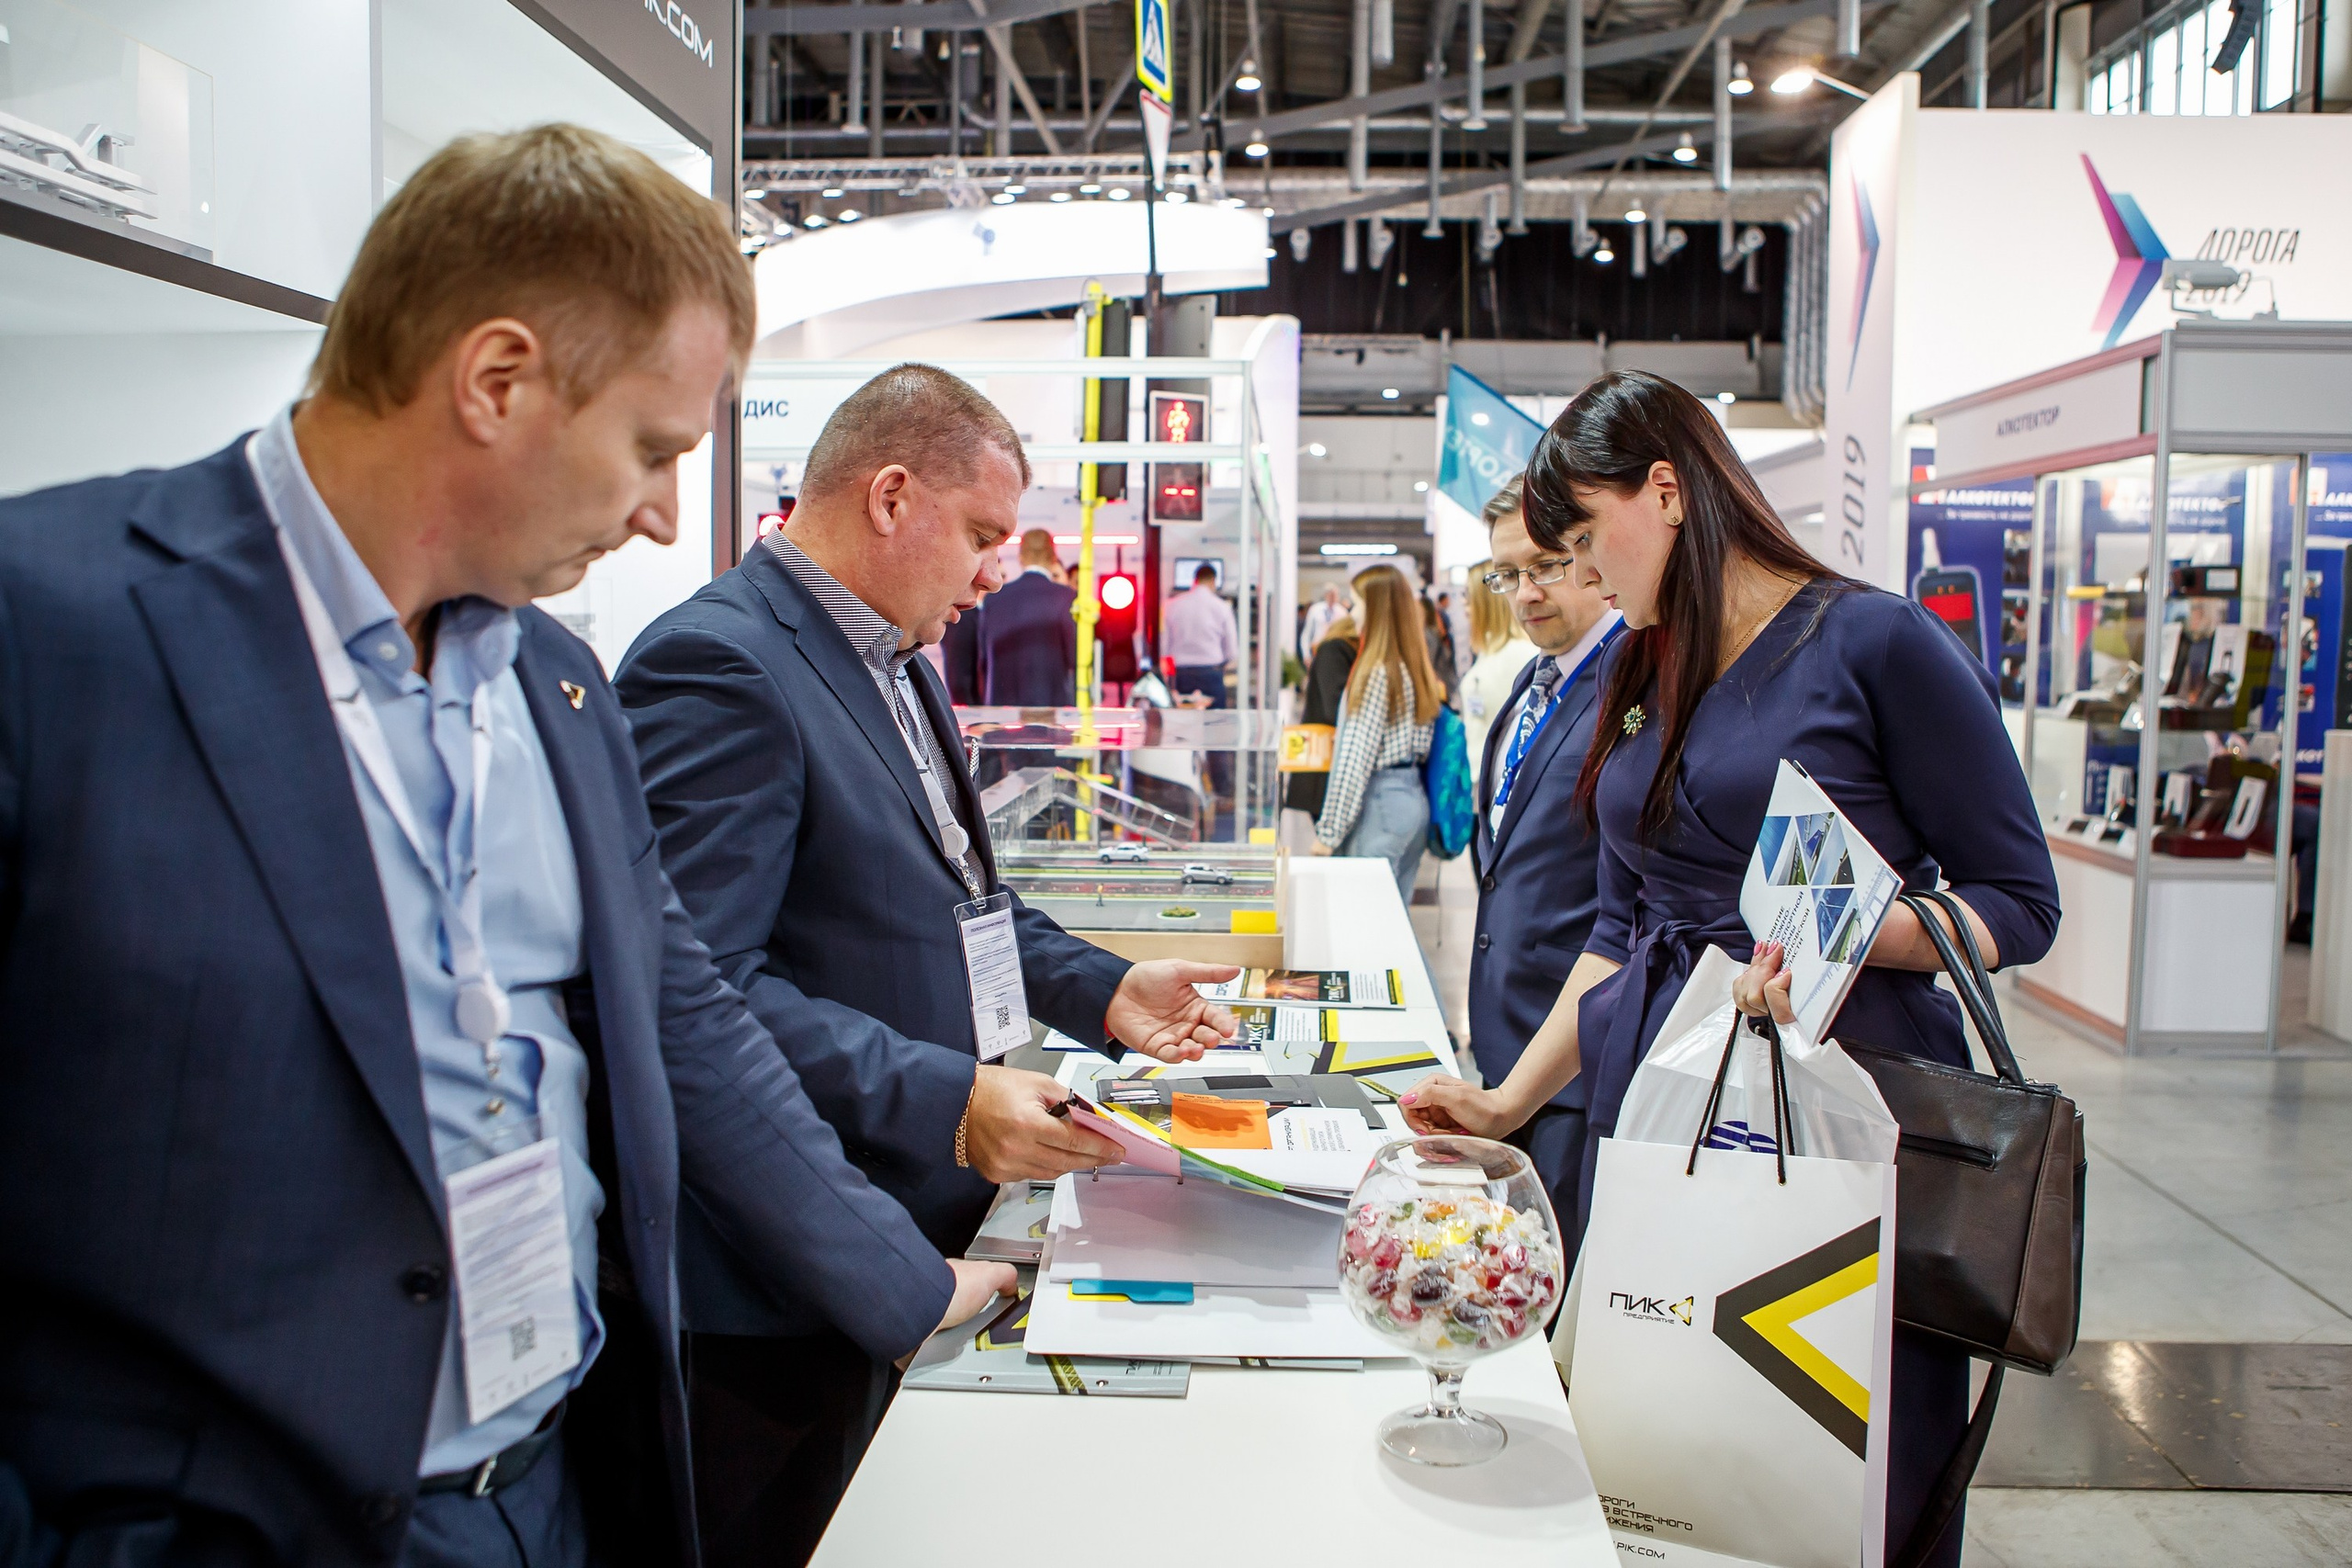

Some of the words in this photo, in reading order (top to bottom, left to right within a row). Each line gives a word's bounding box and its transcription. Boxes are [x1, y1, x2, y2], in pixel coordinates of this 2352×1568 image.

[2195, 228, 2300, 264] ДОРОГА
[743, 400, 789, 420] ДИС
[1841, 434, 1866, 566] 2019
[1766, 905, 1785, 946] АЗВИТИЕ
[1783, 924, 1797, 952] ТЕМЫ
[1781, 908, 1810, 970] ЛЬЯНОВСКОЙ
[1787, 936, 1804, 969] ЛАСТИ
[1610, 1292, 1667, 1316] ПИК
[1623, 1312, 1675, 1325] ПРЕДПРИЯТИЕ
[1598, 1494, 1635, 1509] ОРОГИ
[1606, 1516, 1655, 1533] ИЖЕНИЯ
[1612, 1506, 1693, 1531] ВСТРЕЧНОГО
[1613, 1540, 1666, 1560] PIK.COM
